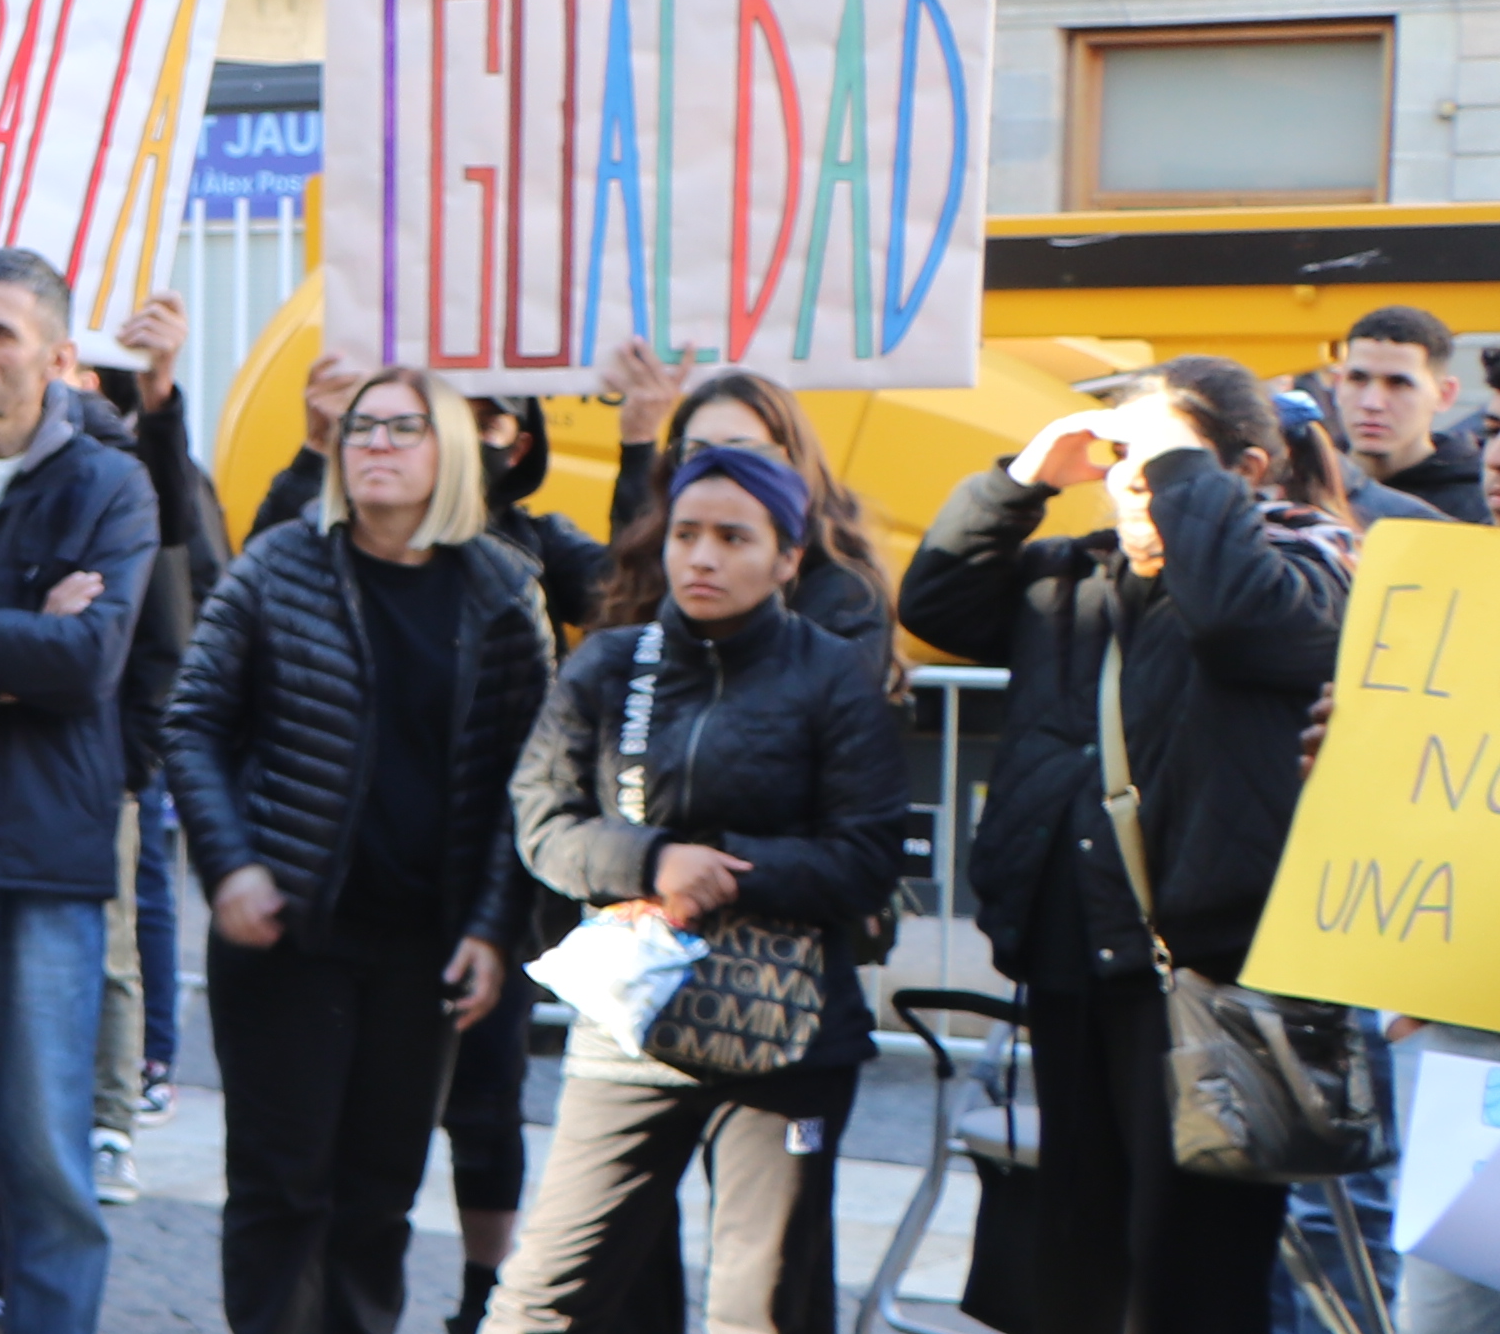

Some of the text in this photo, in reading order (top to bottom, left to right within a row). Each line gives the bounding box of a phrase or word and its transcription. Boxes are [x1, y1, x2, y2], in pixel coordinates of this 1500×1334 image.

[1361, 584, 1459, 699] EL
[618, 673, 658, 755] BIMBA
[1314, 858, 1458, 944] UNA
